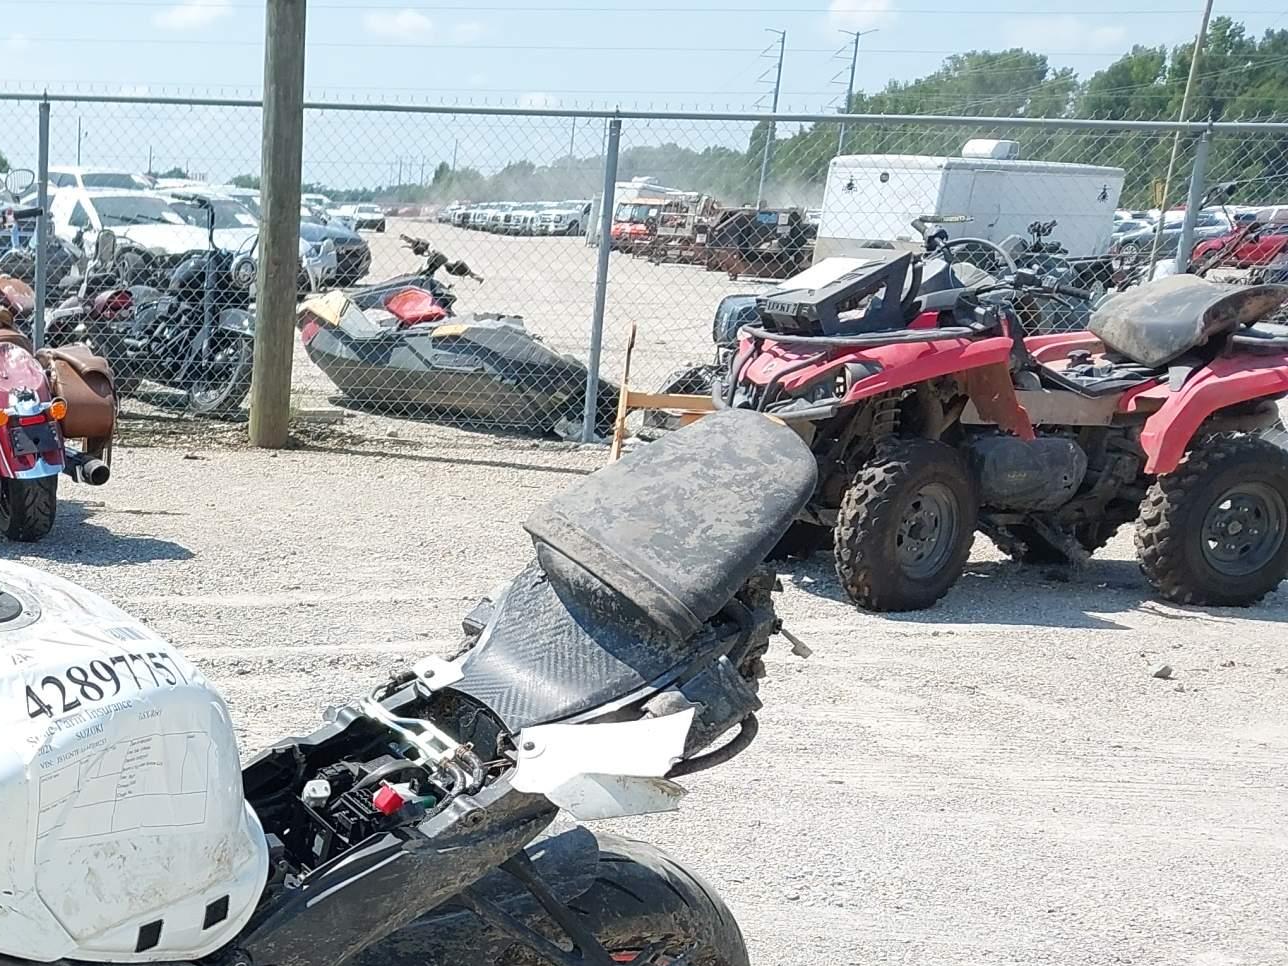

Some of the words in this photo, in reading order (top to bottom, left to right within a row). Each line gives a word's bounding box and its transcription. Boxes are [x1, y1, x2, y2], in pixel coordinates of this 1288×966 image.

[25, 652, 189, 719] 42897757
[85, 699, 133, 720] Insurance
[75, 723, 104, 741] SUZUKI
